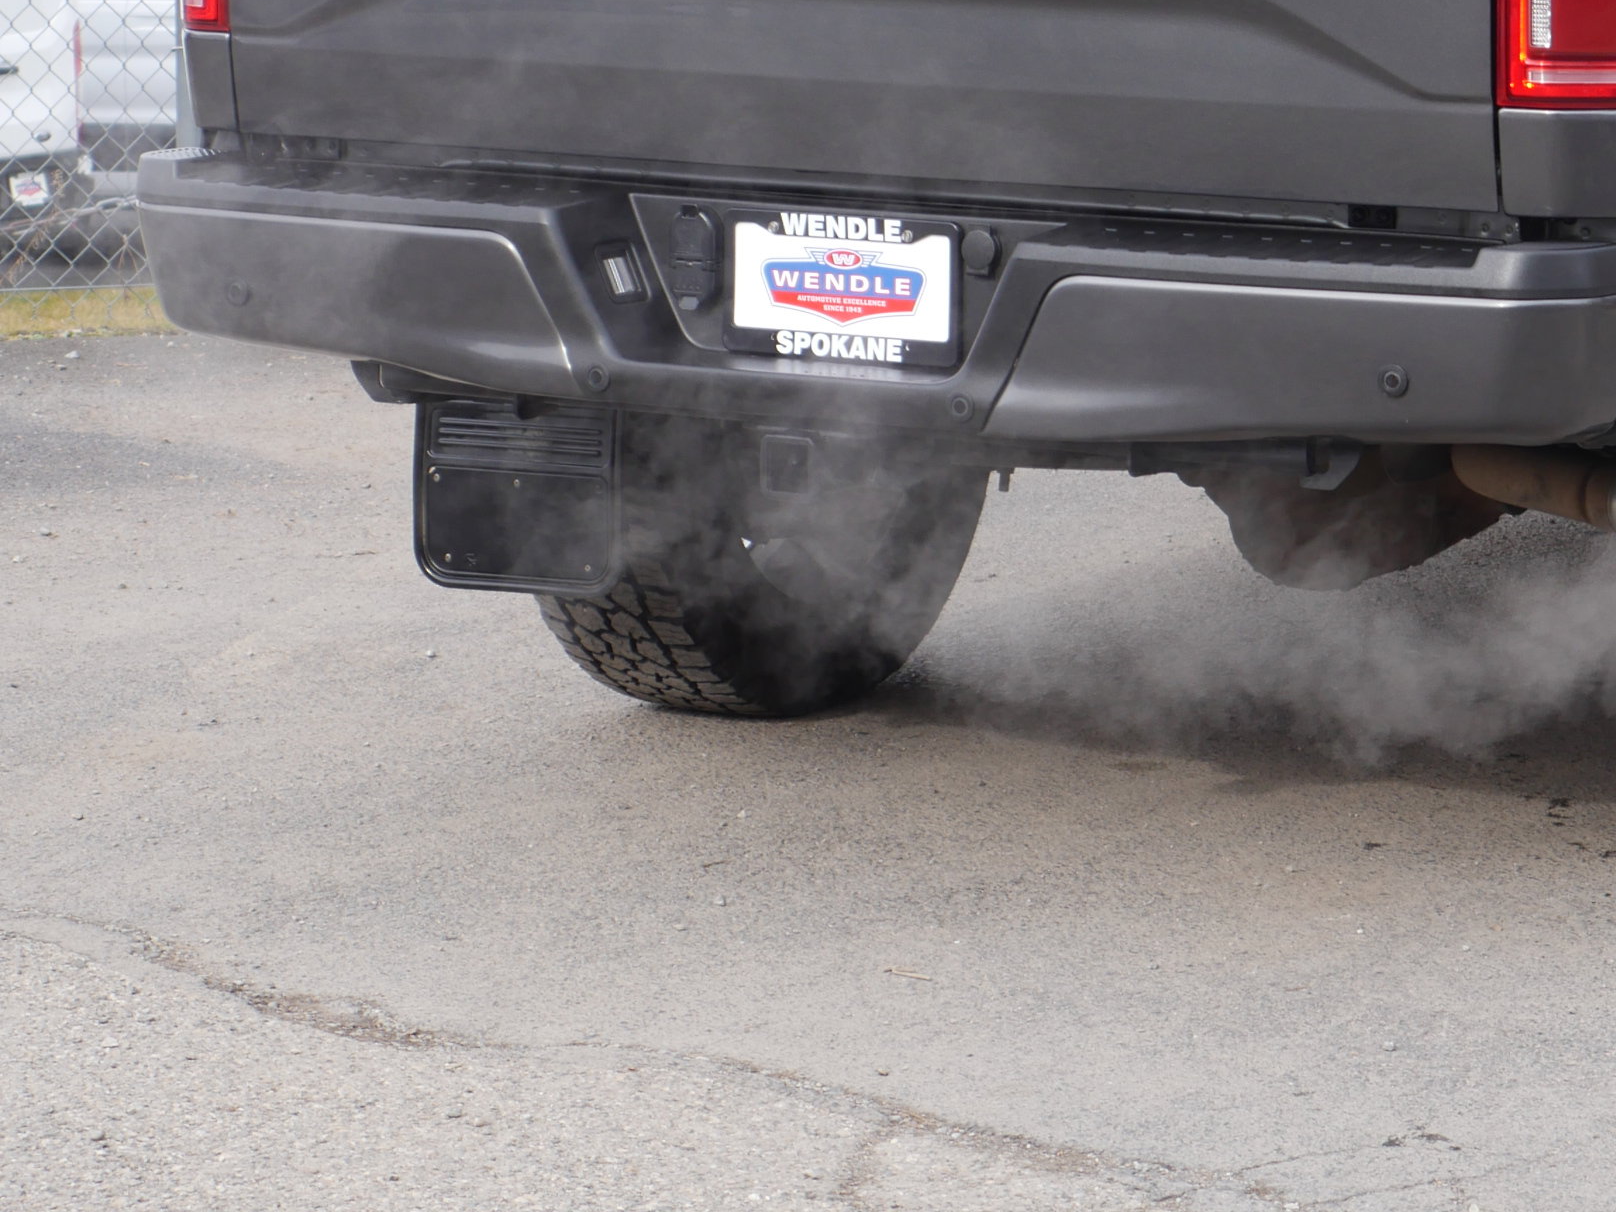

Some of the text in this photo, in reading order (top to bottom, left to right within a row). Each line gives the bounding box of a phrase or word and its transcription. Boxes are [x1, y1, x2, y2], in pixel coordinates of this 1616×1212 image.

[780, 212, 903, 244] WENDLE
[772, 269, 911, 296] WENDLE
[797, 294, 887, 307] AUTOMOTIVE EXCELLENCE
[823, 304, 845, 313] SINCE
[775, 329, 903, 363] SPOKANE
